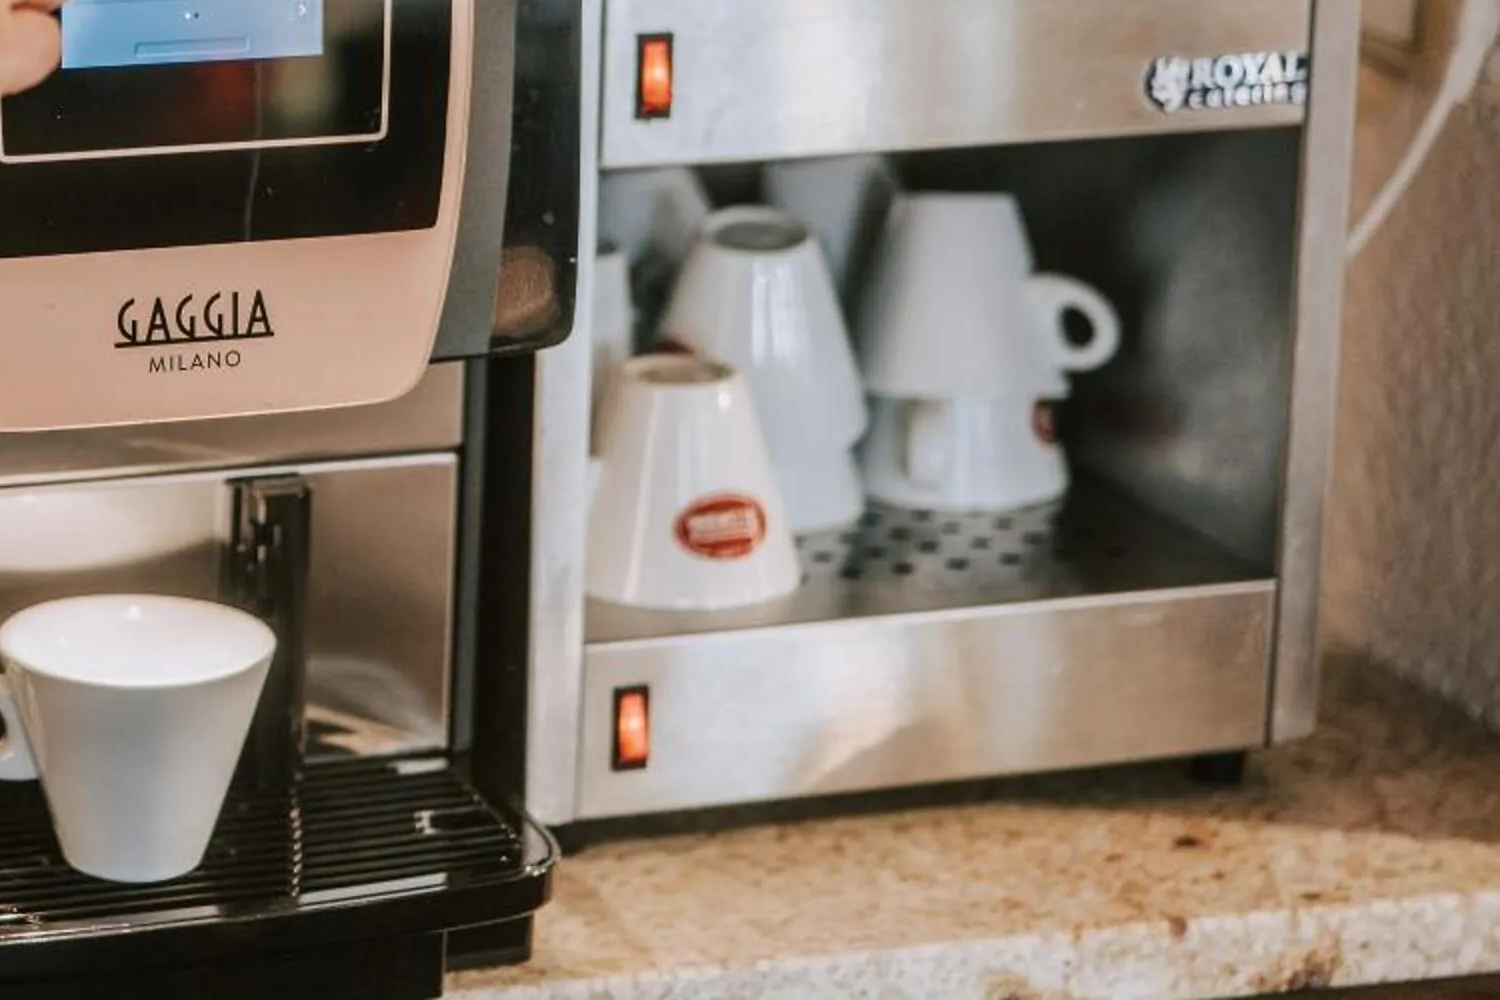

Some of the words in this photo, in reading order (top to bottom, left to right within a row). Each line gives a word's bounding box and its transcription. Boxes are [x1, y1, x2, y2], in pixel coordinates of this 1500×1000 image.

[1190, 51, 1308, 90] ROYAL
[117, 288, 272, 344] GAGGIA
[148, 350, 241, 373] MILANO
